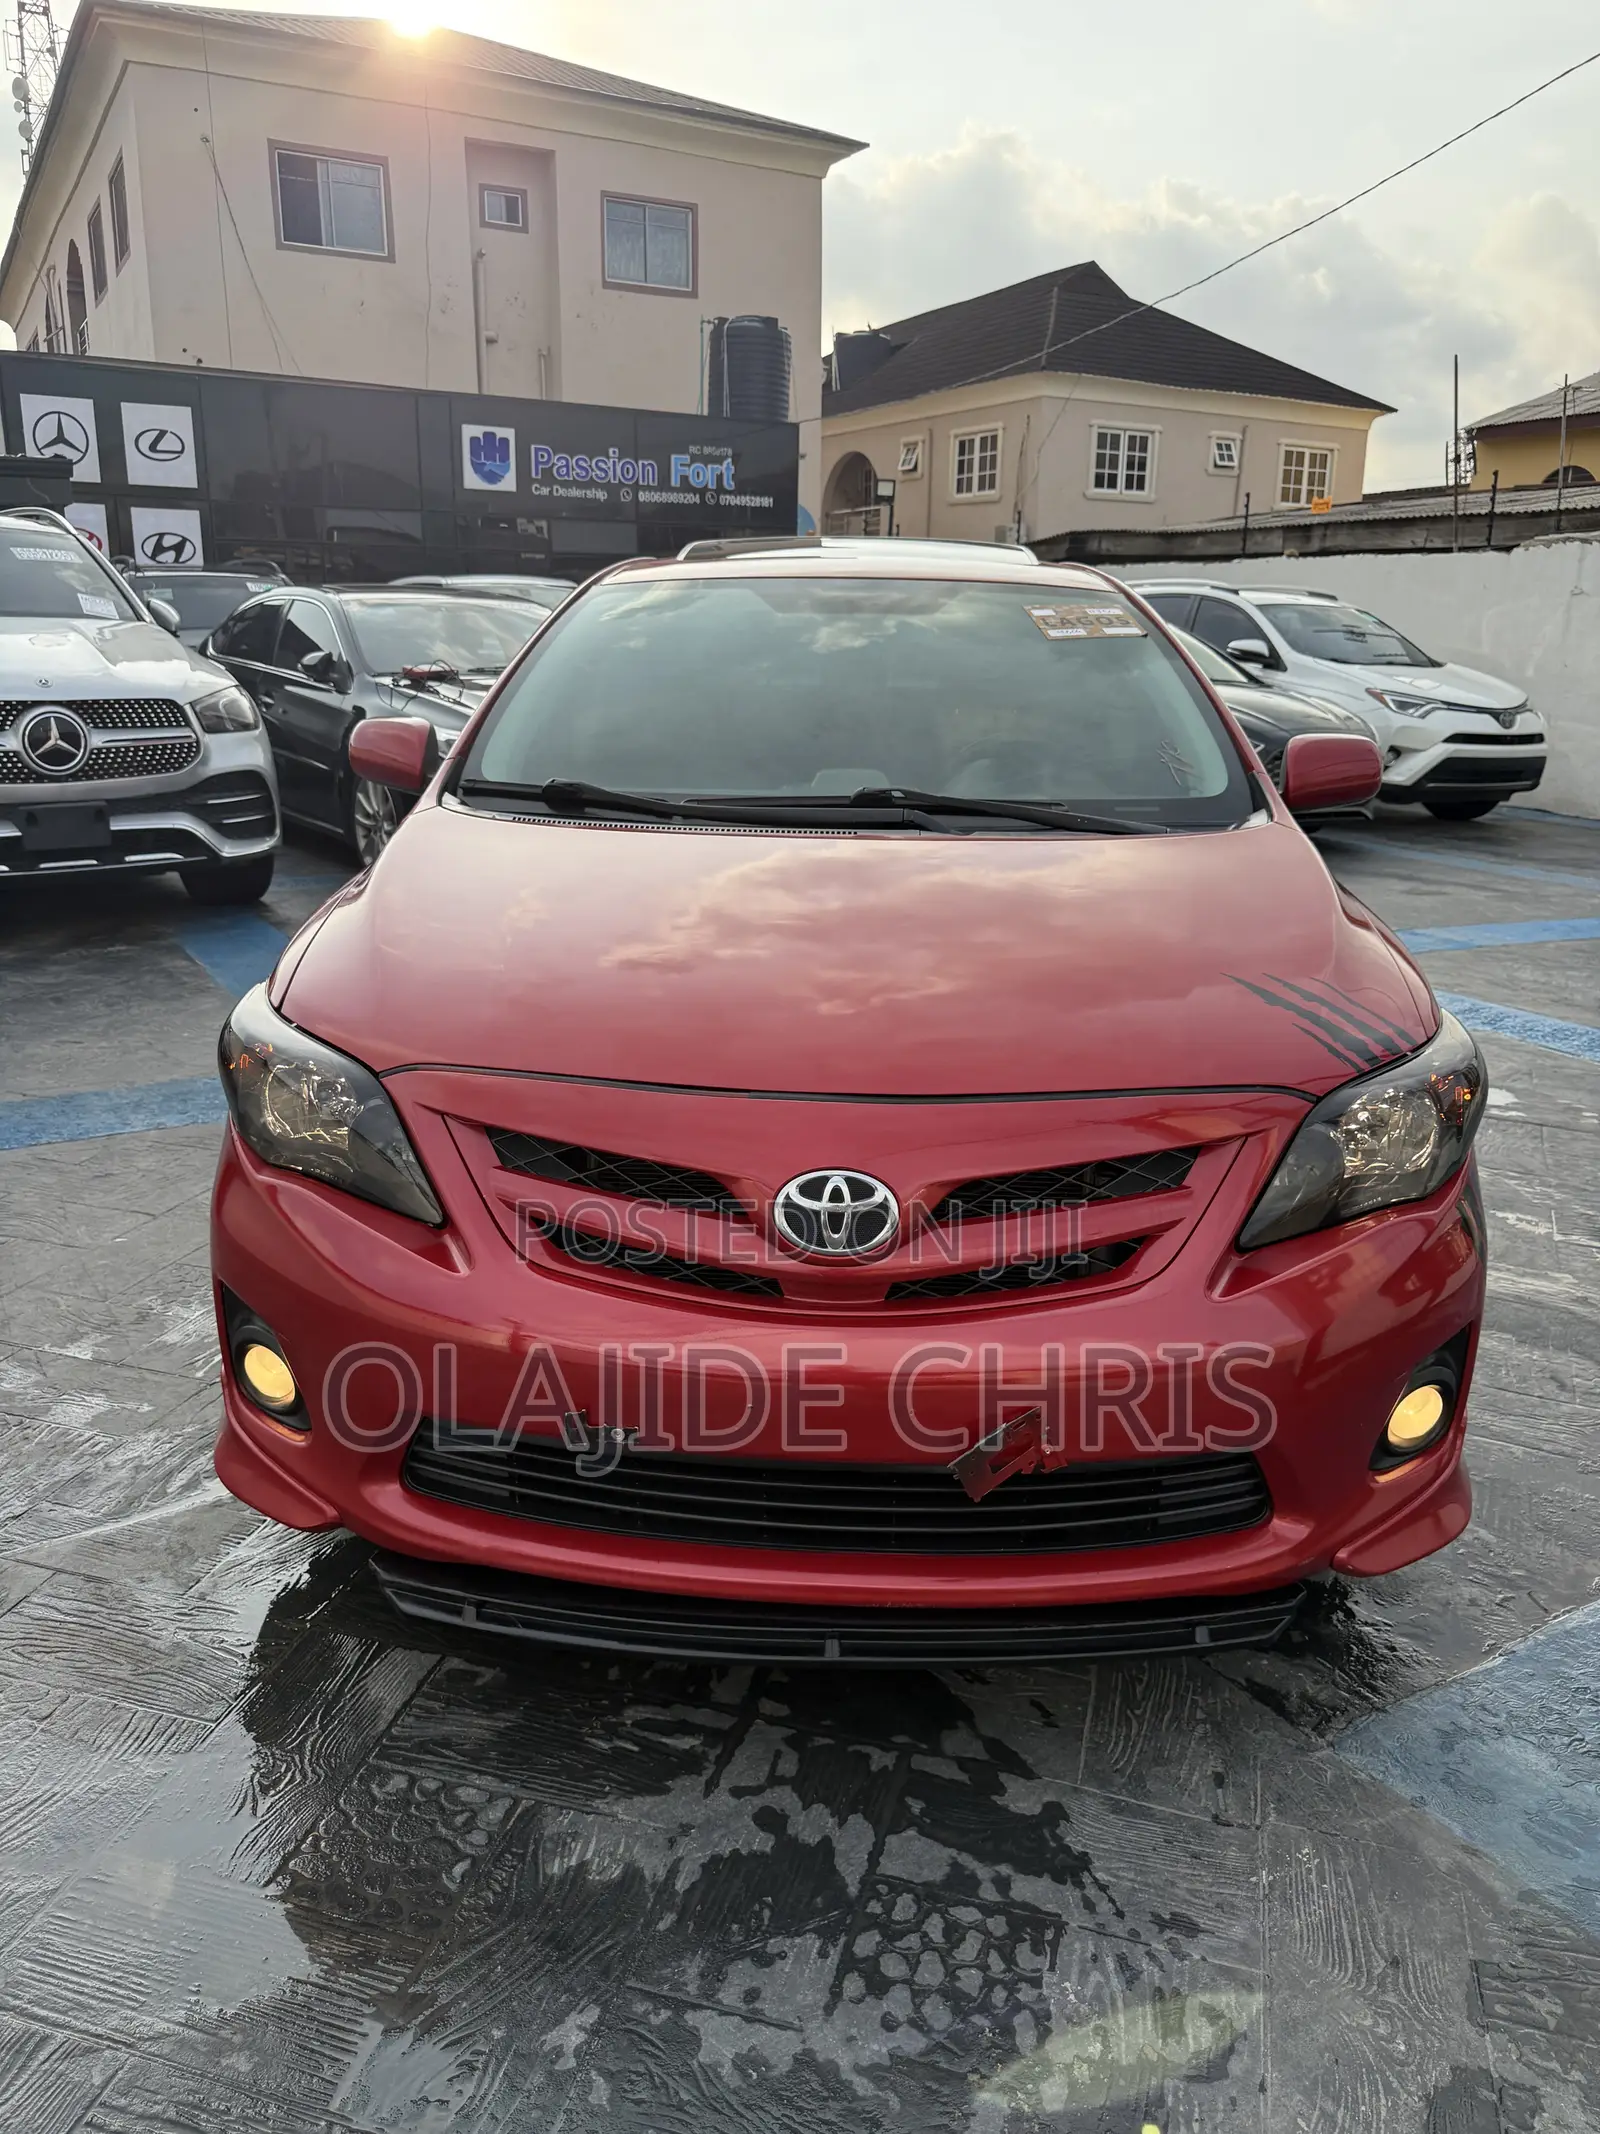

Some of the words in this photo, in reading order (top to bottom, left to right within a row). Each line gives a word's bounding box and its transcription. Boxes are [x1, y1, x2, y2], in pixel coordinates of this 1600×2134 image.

[531, 444, 658, 486] Passion
[671, 453, 735, 490] Fort
[532, 483, 551, 497] Car
[553, 485, 608, 502] Dealership
[1041, 616, 1130, 627] LAGOS
